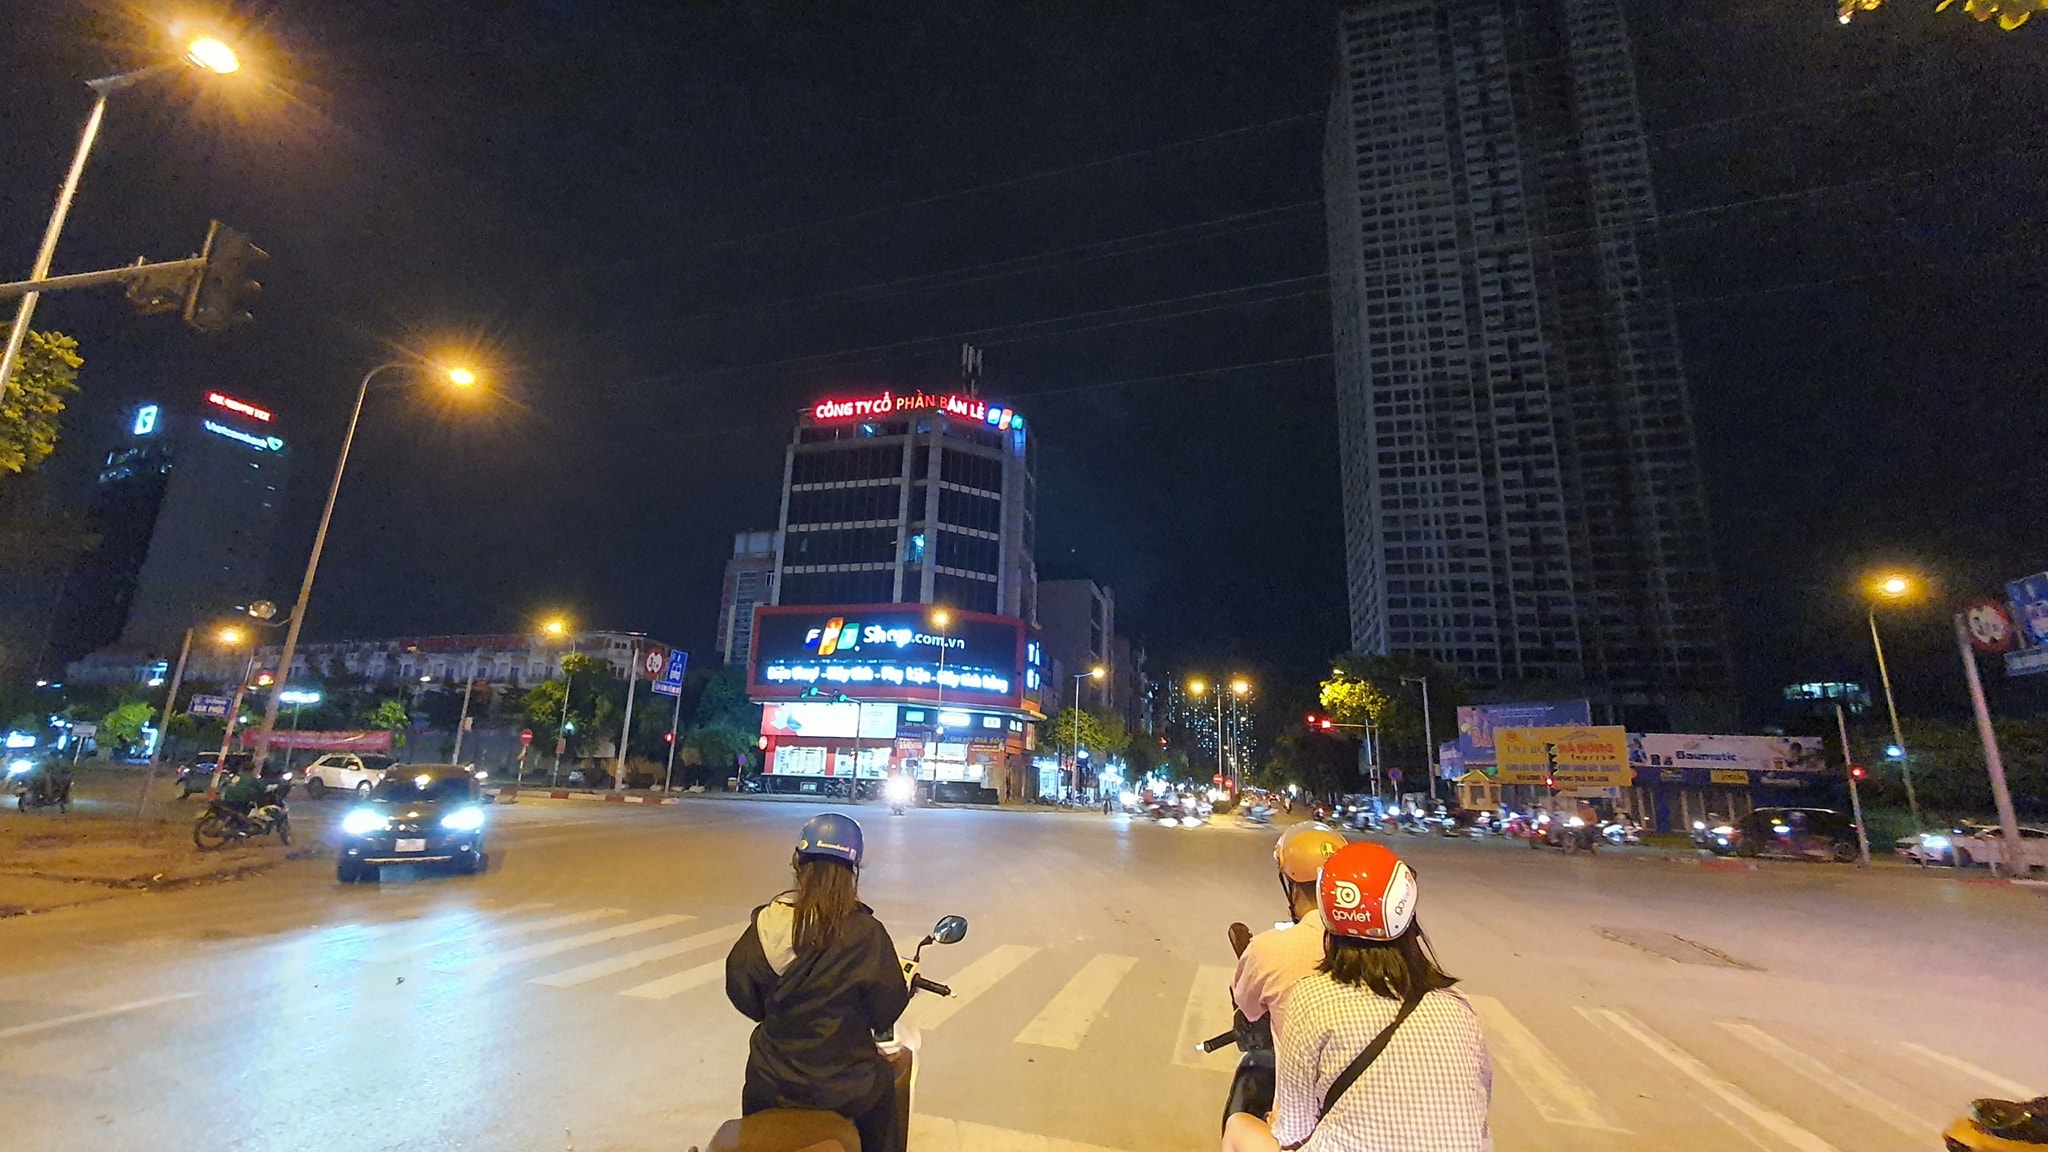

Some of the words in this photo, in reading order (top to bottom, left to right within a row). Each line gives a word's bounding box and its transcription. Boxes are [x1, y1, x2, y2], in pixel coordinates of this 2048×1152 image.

[816, 400, 852, 419] CÔNG
[896, 389, 936, 411] PHẦN
[939, 395, 968, 416] BÁN
[969, 402, 985, 420] LẺ
[804, 620, 859, 651] FPT
